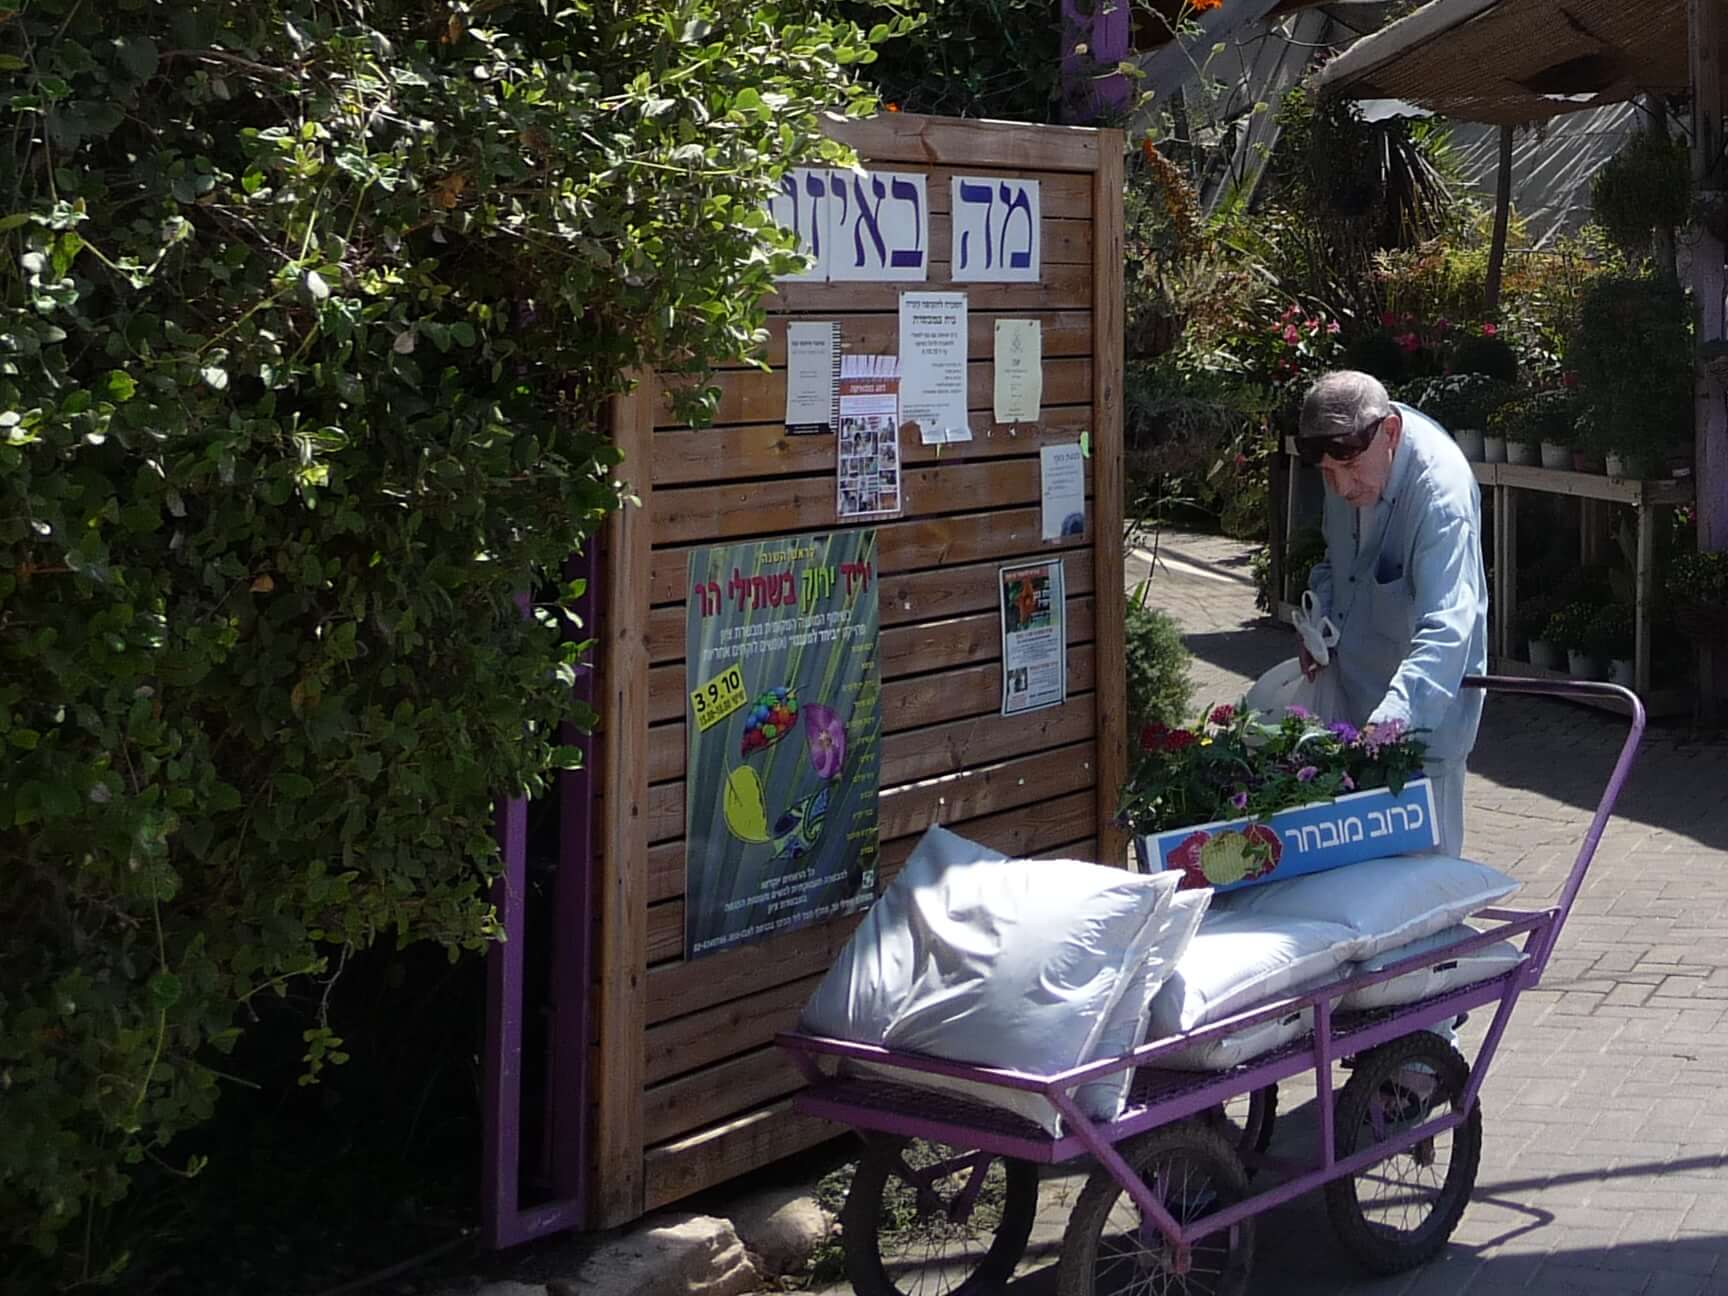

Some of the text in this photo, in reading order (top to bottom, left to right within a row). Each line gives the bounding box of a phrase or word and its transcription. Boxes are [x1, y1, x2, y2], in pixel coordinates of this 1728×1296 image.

[767, 170, 1033, 270] מה באיזו
[694, 580, 722, 618] הר
[728, 567, 797, 613] בשתילי
[802, 565, 836, 614] ירוק
[1285, 803, 1424, 853] כרוב מובחר
